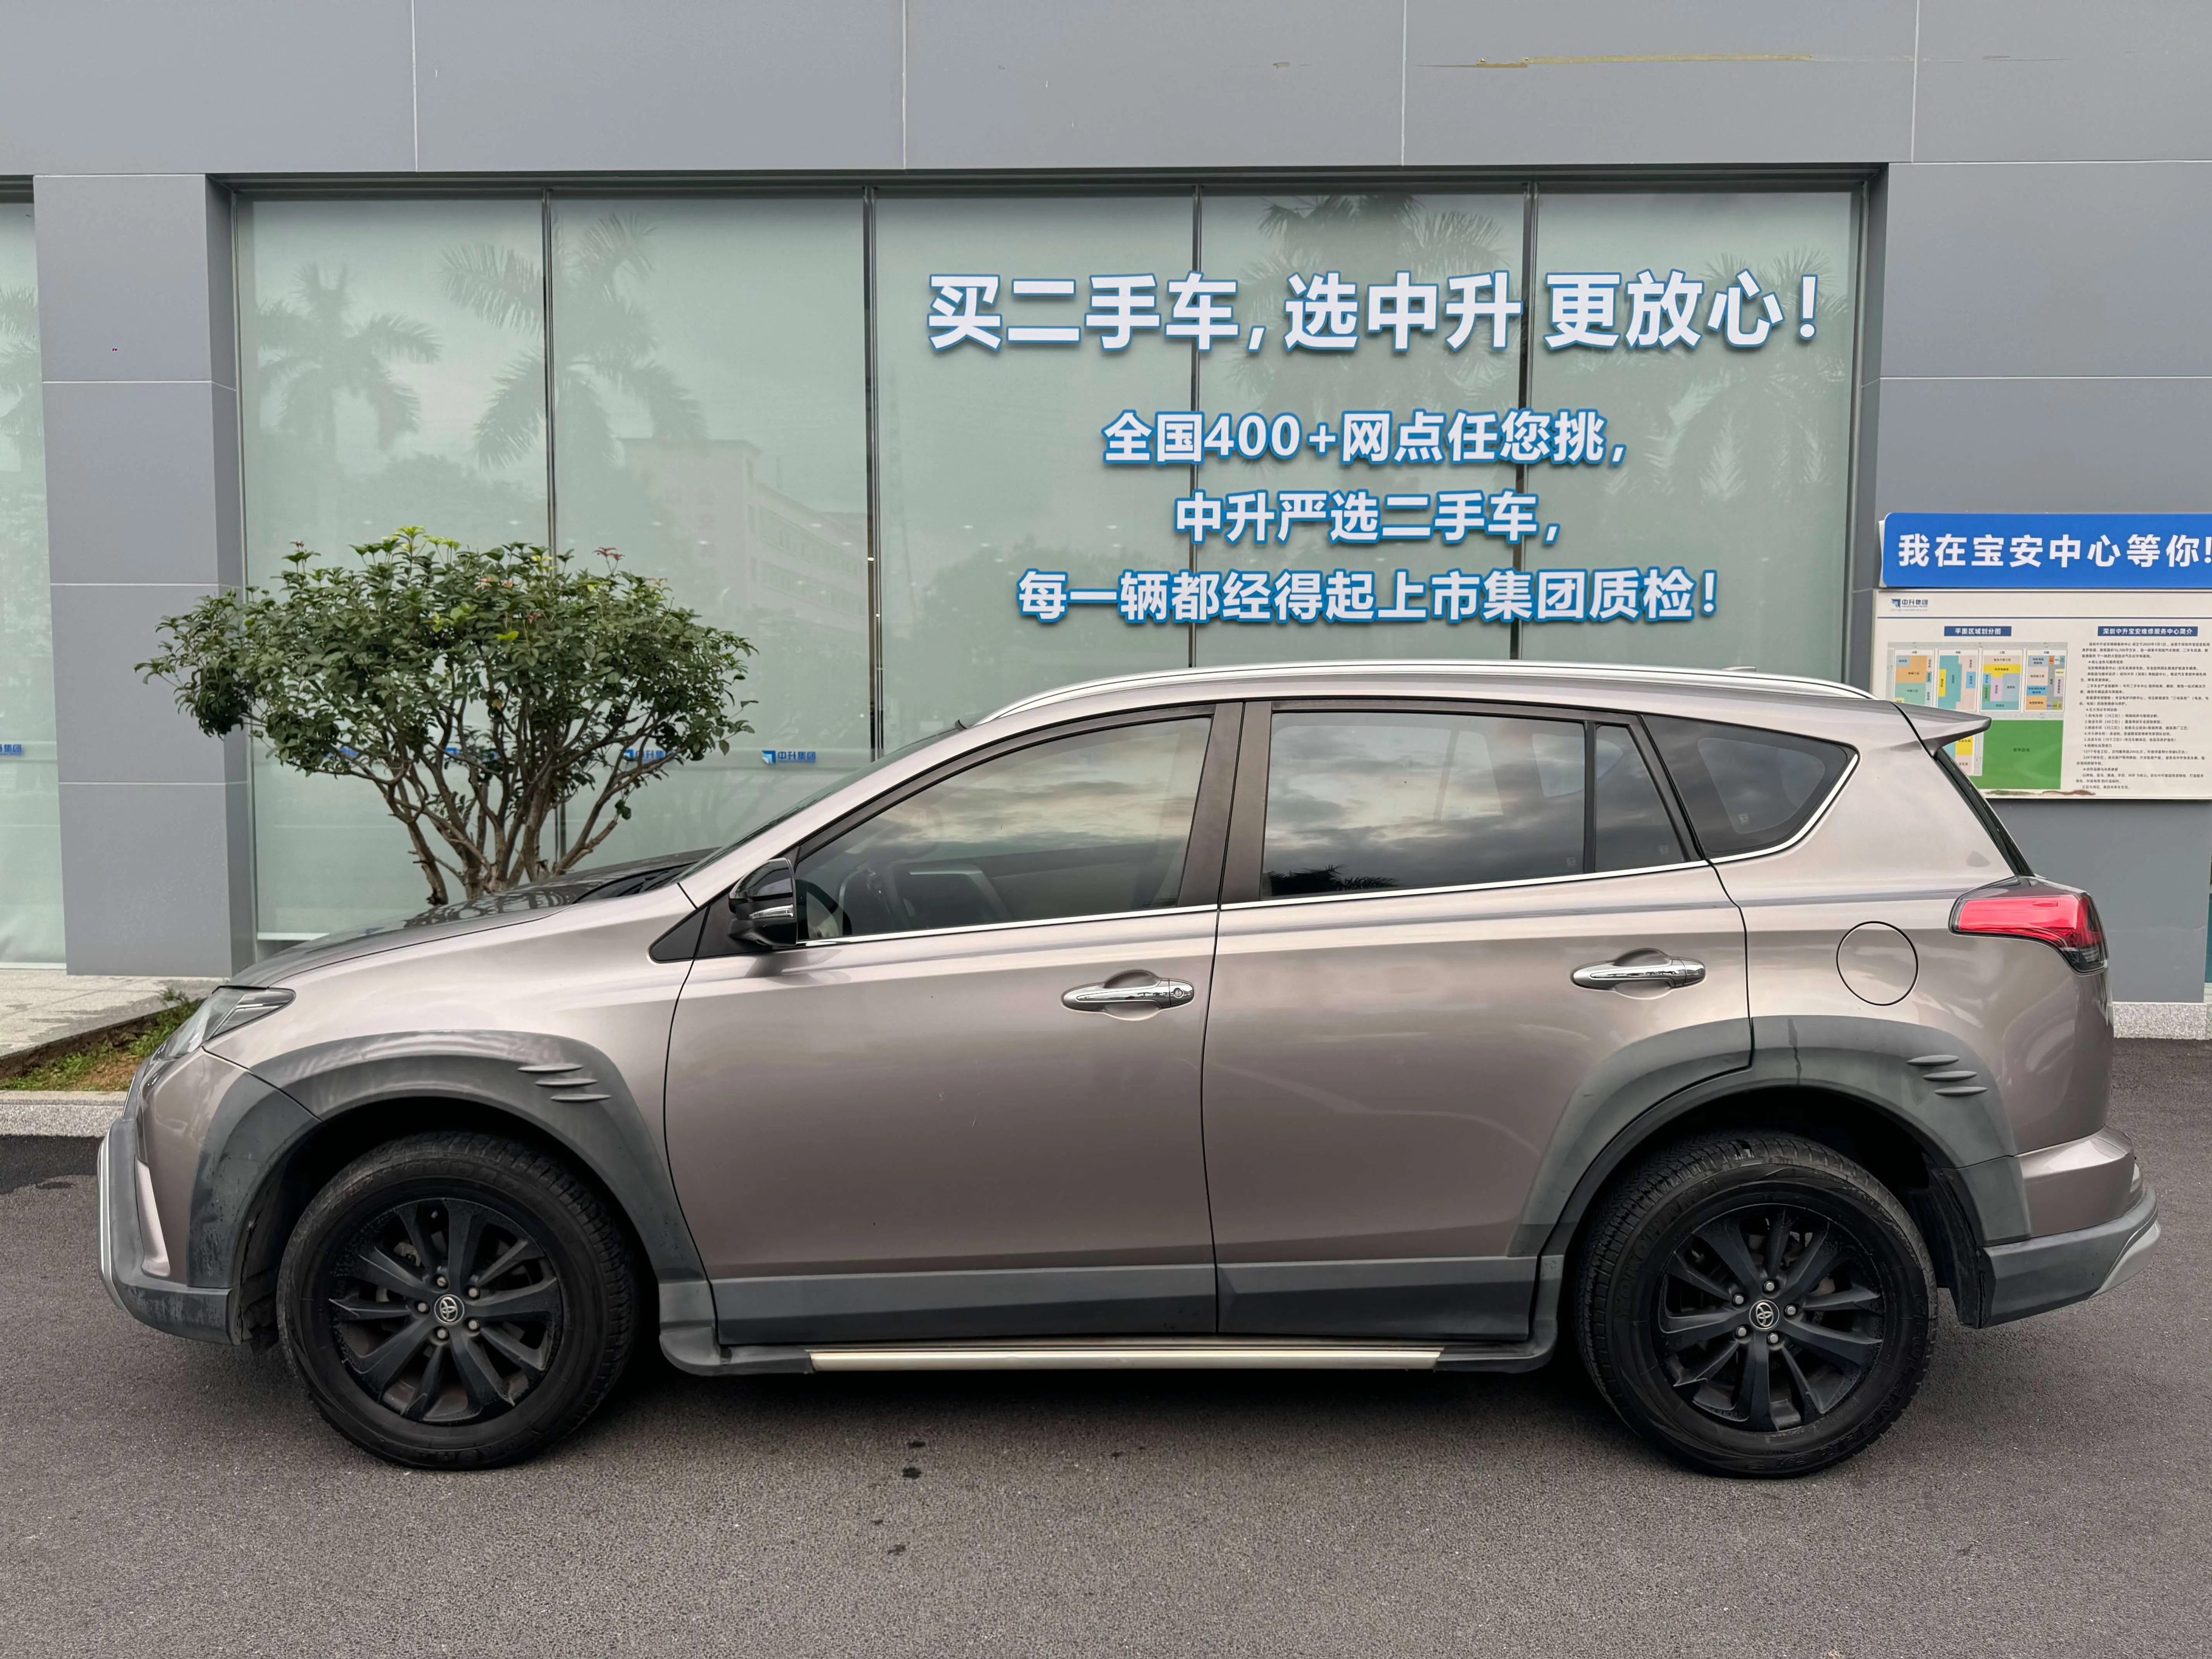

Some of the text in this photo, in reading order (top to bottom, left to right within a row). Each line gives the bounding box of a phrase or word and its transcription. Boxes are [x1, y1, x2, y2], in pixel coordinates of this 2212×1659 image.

[1102, 409, 1626, 464] 全国400+网点任您挑，
[1175, 488, 1560, 545] 中升严选二手车，
[1899, 534, 2212, 568] 我在宝安中心等你！
[1018, 567, 1717, 623] 每一辆都经得起上市集团质检！
[778, 751, 816, 761] 中升集团
